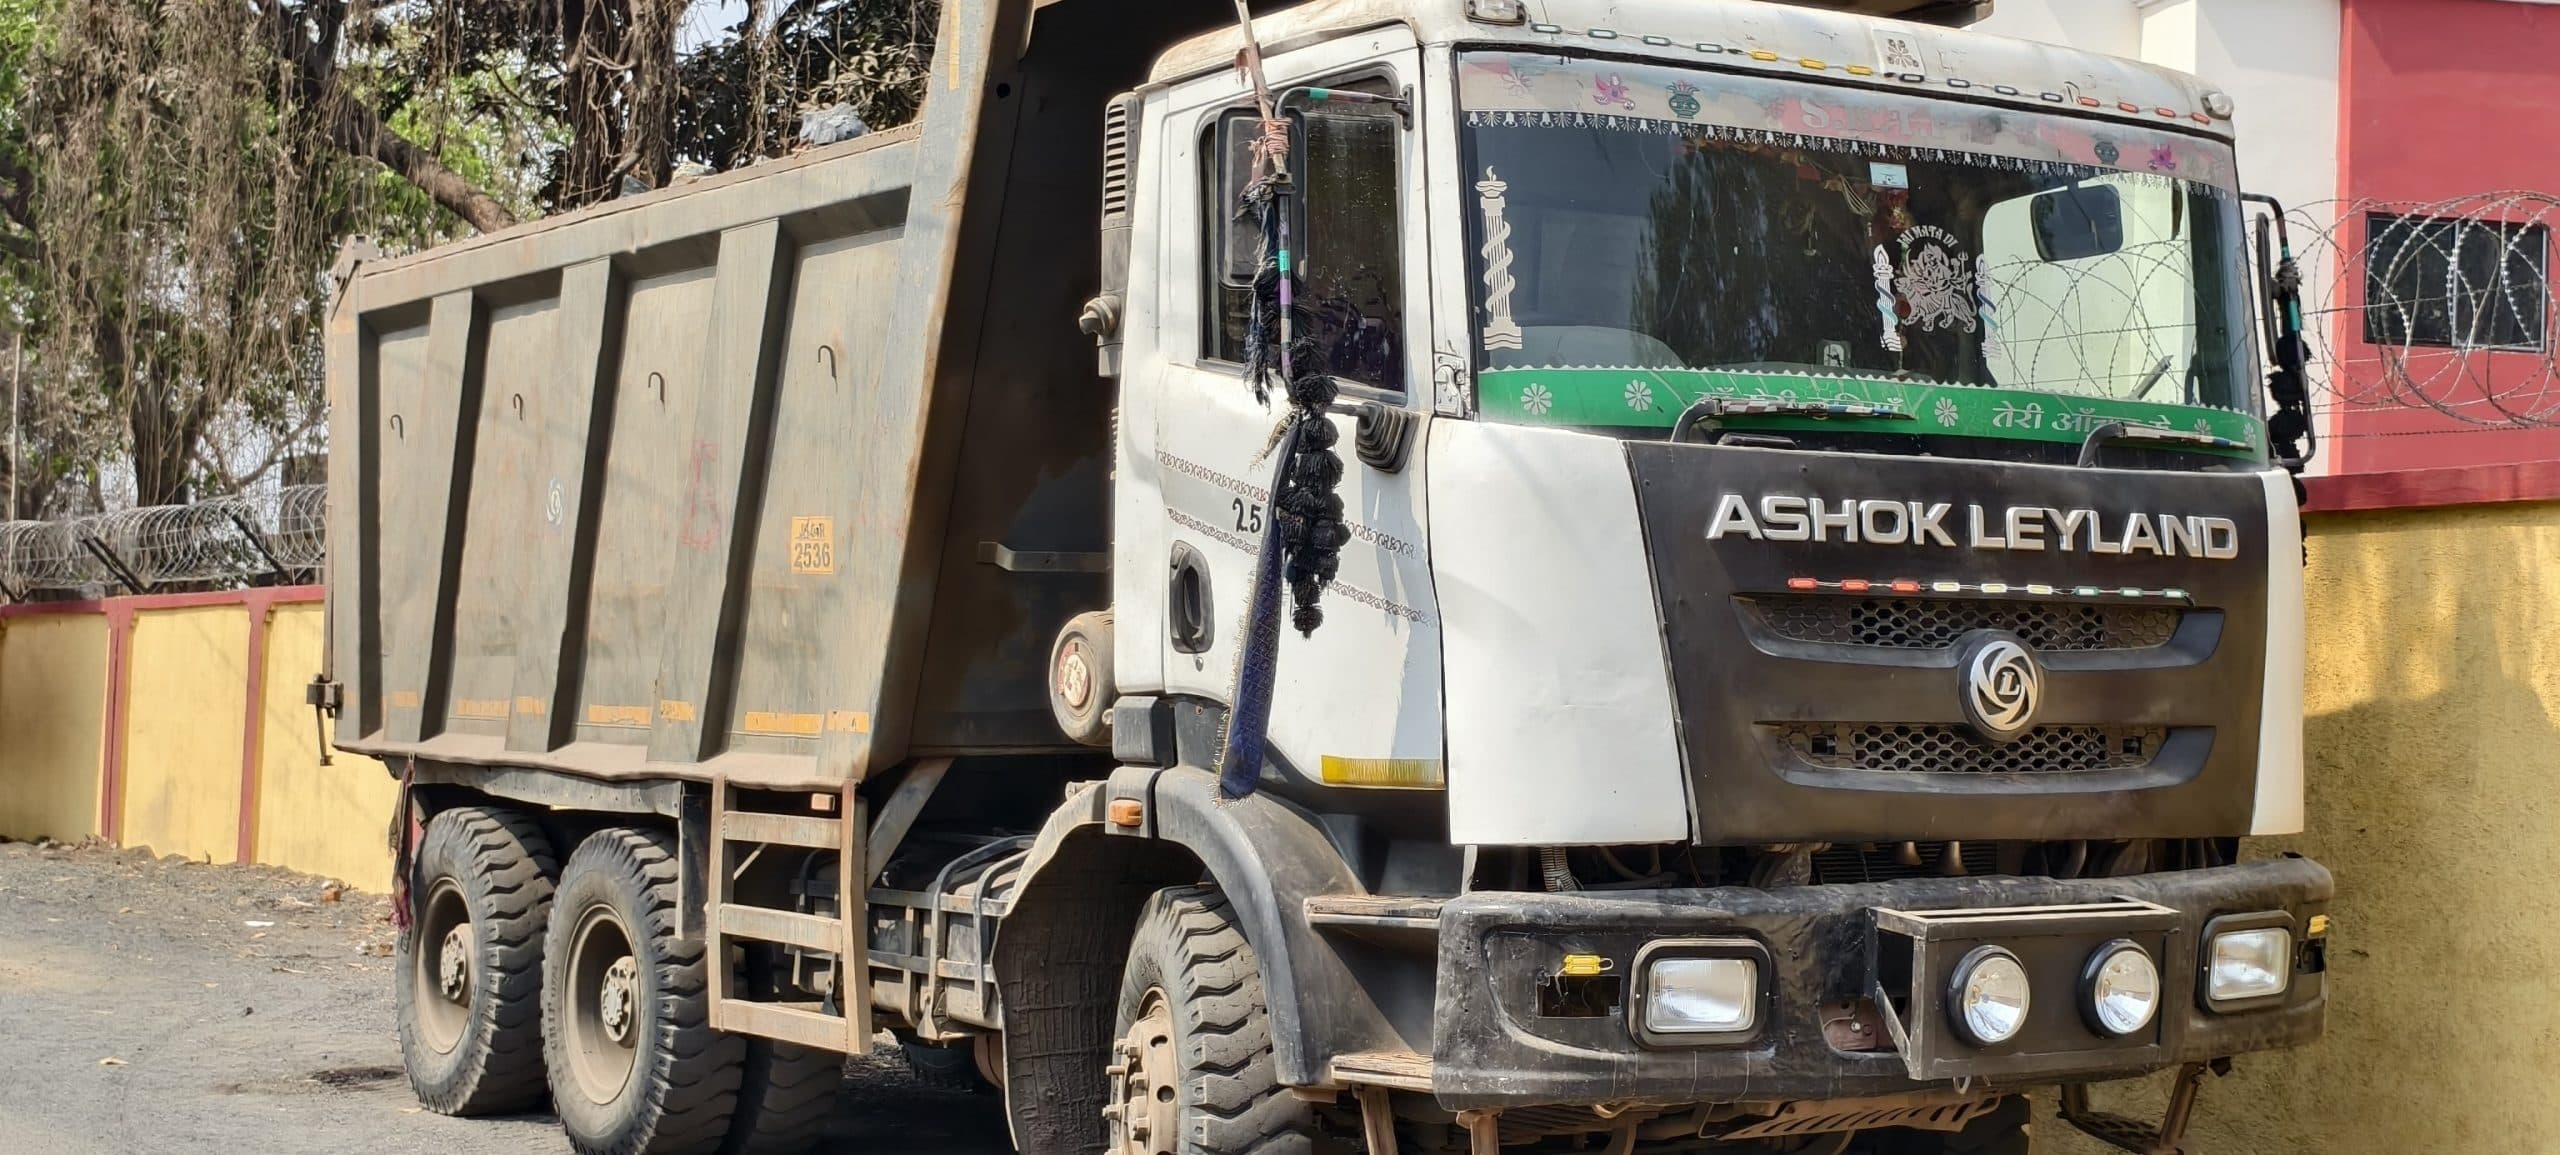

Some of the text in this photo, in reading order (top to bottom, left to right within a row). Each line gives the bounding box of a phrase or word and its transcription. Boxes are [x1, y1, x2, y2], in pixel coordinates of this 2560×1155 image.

[1896, 225, 1959, 249] JAI MATA DI
[1992, 400, 2045, 430] तेरी
[1232, 497, 1262, 533] 25
[1706, 494, 2239, 560] ASHOK LEYLAND
[793, 542, 831, 568] 2536
[1999, 671, 2021, 696] L
